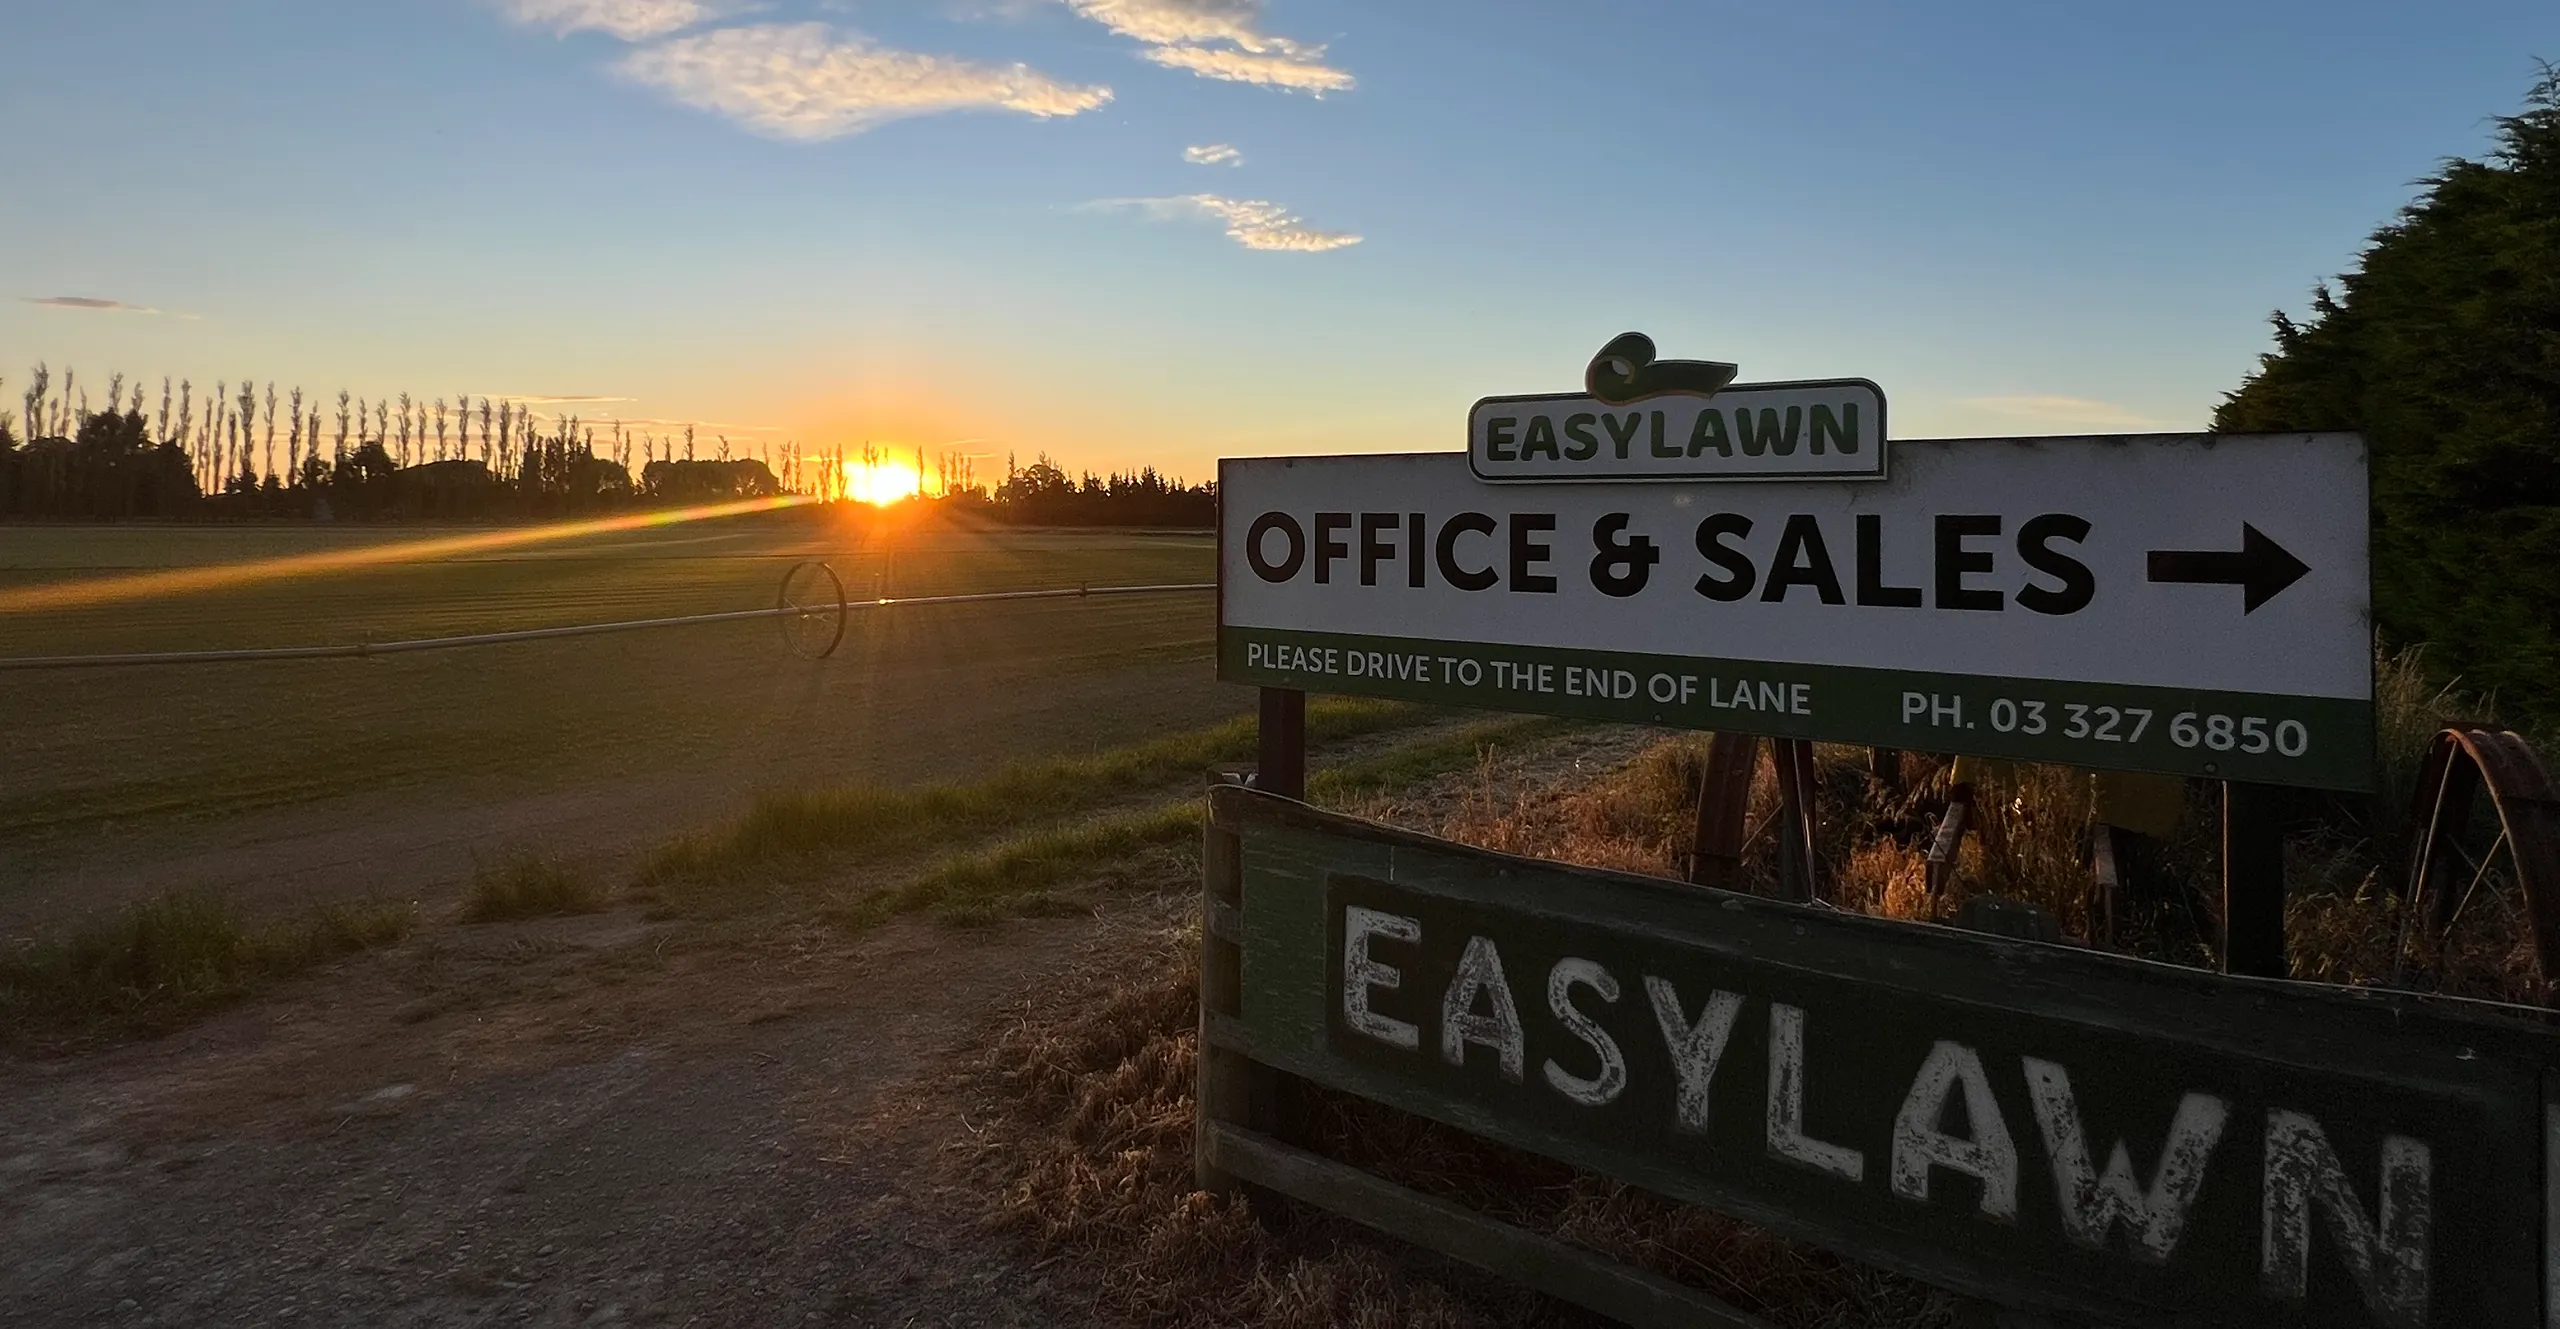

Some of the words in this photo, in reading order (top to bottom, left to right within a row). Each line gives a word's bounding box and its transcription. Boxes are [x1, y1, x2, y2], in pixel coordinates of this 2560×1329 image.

[1486, 403, 1859, 462] EASYLAWN
[1246, 511, 1558, 594] OFFICE
[1588, 512, 1660, 598] &
[1693, 512, 2096, 615] SALES
[1247, 642, 1338, 675] PLEASE
[1347, 649, 1430, 682] DRIVE
[1438, 656, 1482, 688] TO
[1490, 660, 1555, 693] THE
[1565, 666, 1637, 701] END
[1647, 672, 1697, 706] OF
[1710, 678, 1811, 715] LANE
[1901, 691, 1975, 731] PH.
[1990, 698, 2047, 736] 03
[2063, 703, 2153, 745] 327
[2169, 712, 2309, 758] 6850
[1343, 905, 2433, 1329] EASYLAWN
